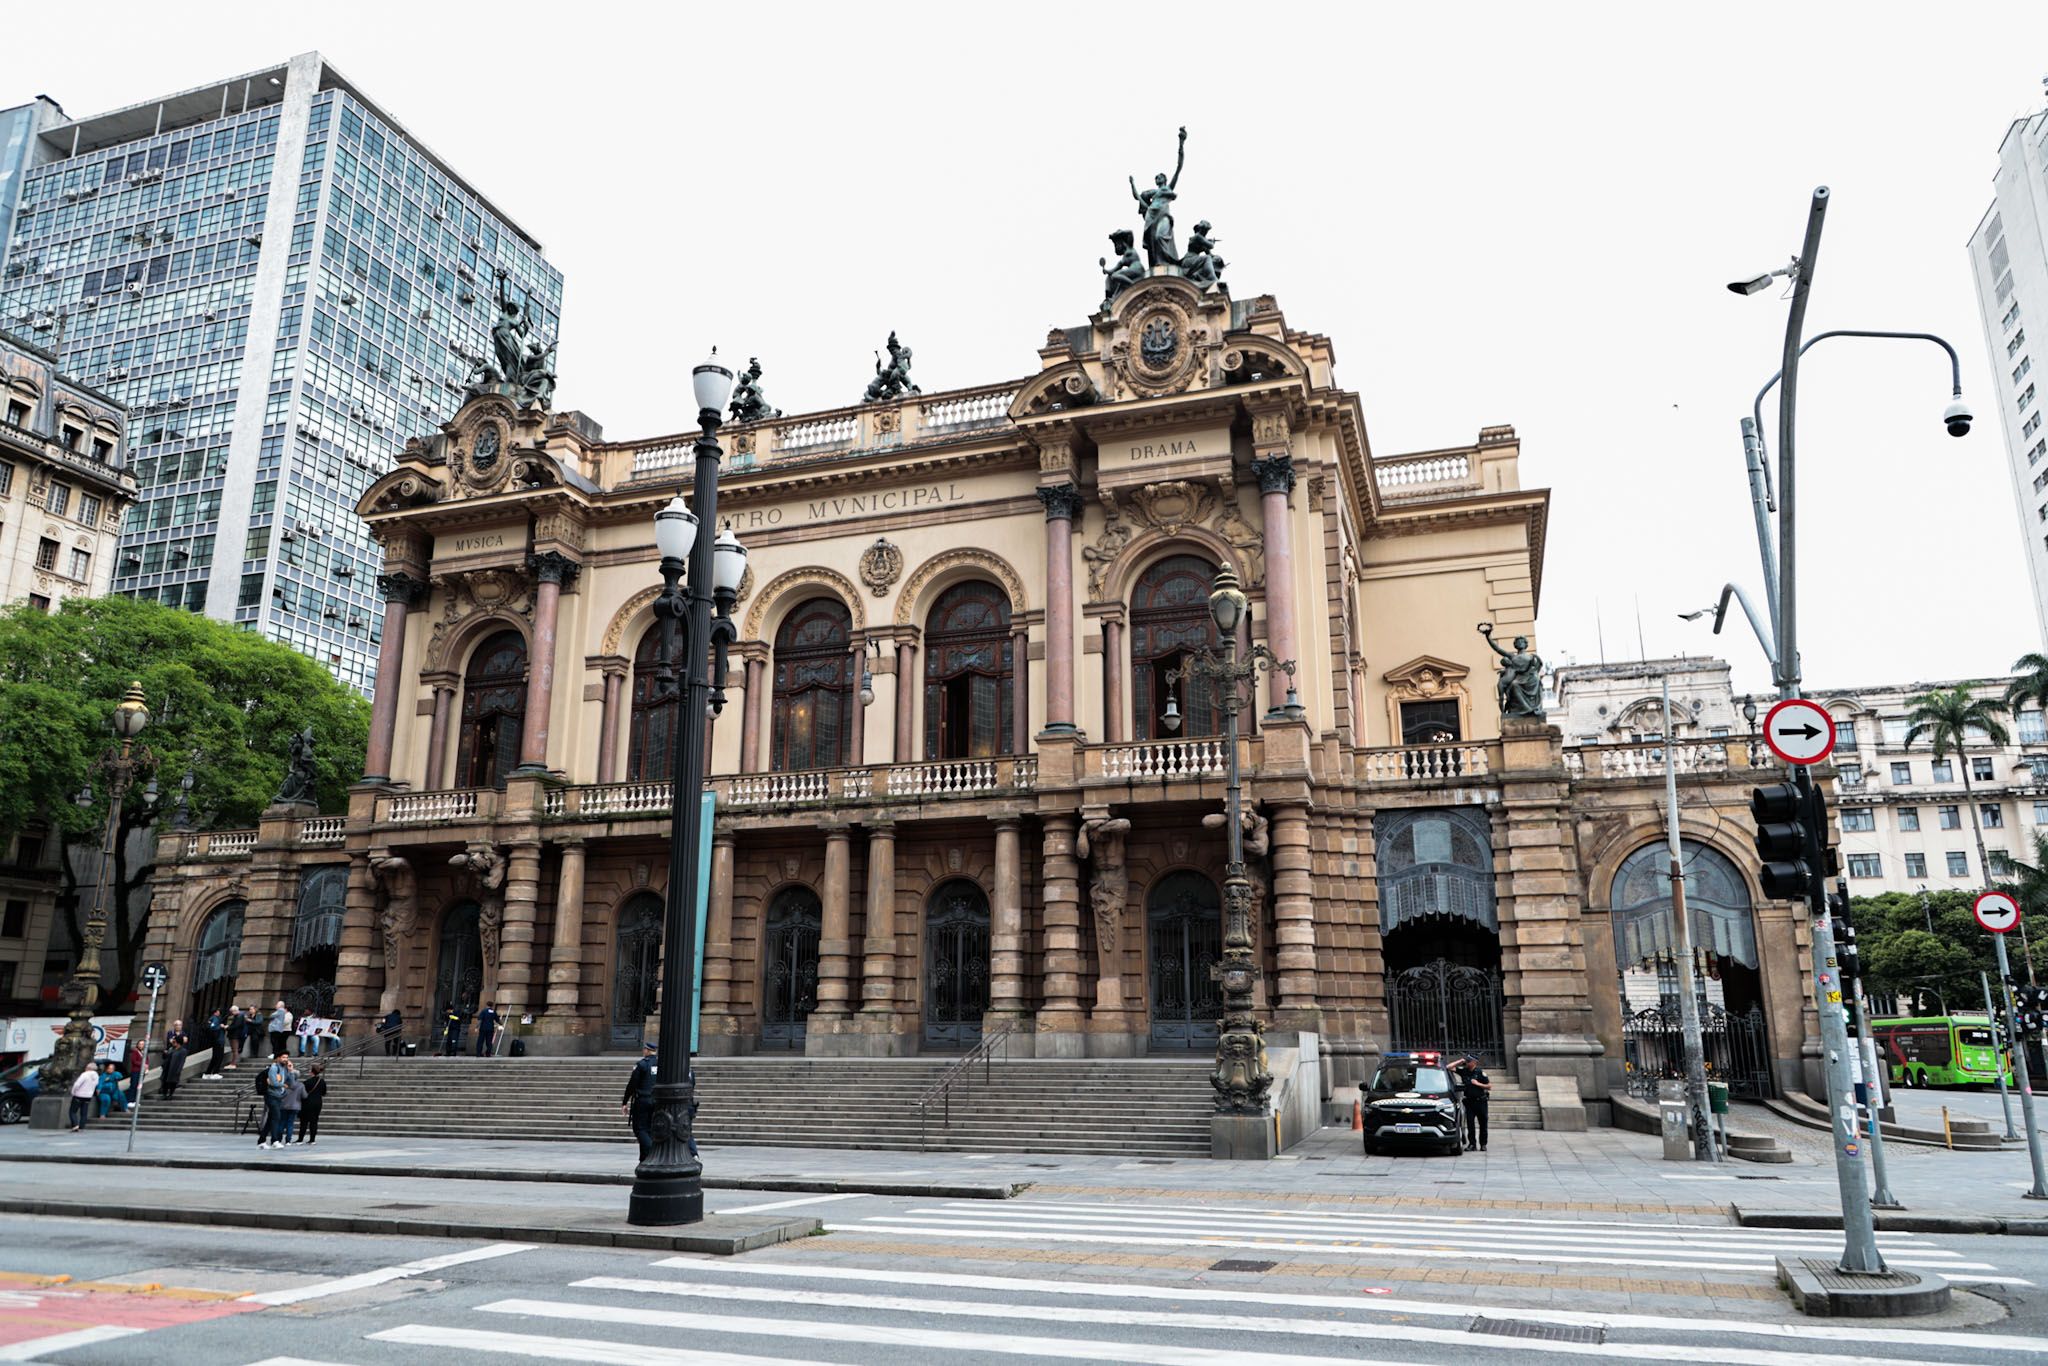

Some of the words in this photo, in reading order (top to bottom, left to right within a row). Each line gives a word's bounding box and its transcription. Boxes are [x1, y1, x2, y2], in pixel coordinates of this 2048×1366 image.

[1131, 440, 1197, 460] DRAMA
[717, 508, 783, 531] ATRO
[808, 484, 965, 520] MVNICIPAL
[455, 535, 503, 551] MVSICA
